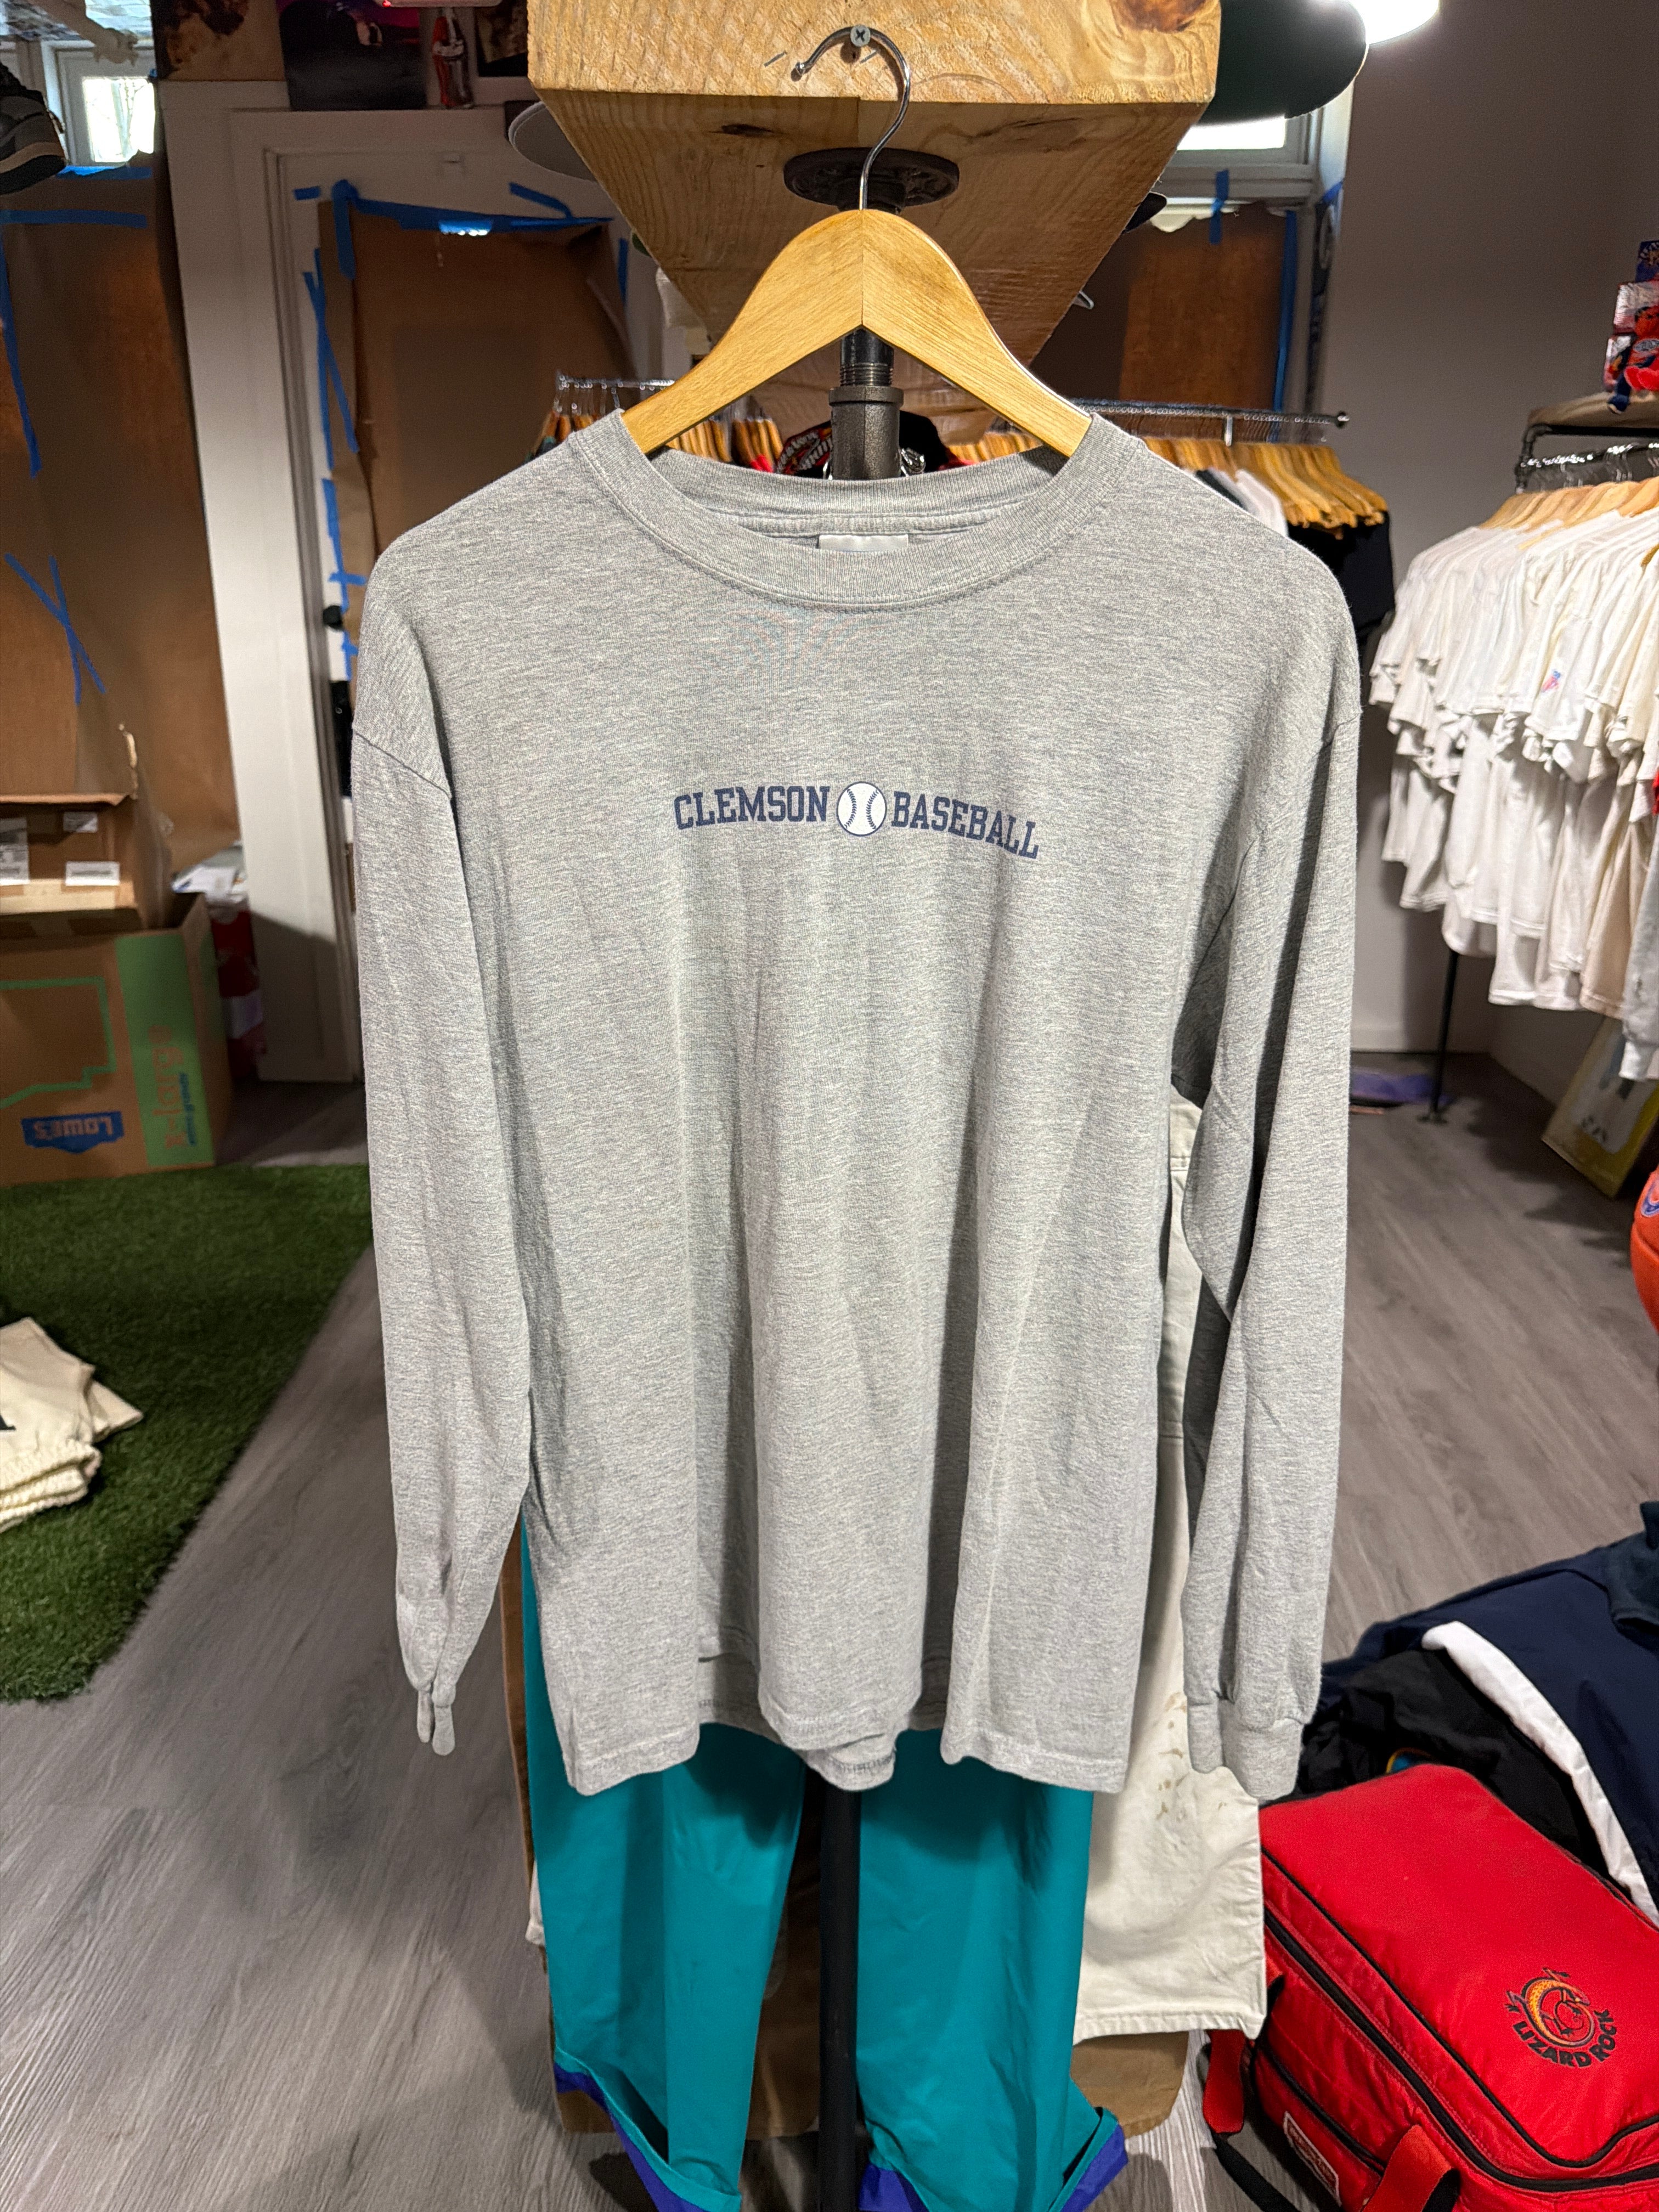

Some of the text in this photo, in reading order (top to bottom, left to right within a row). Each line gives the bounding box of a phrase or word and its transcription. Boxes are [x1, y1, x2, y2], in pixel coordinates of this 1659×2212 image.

[673, 786, 1039, 859] CLEMSON BASEBALL
[1513, 2008, 1617, 2068] LIZARD ROCK
